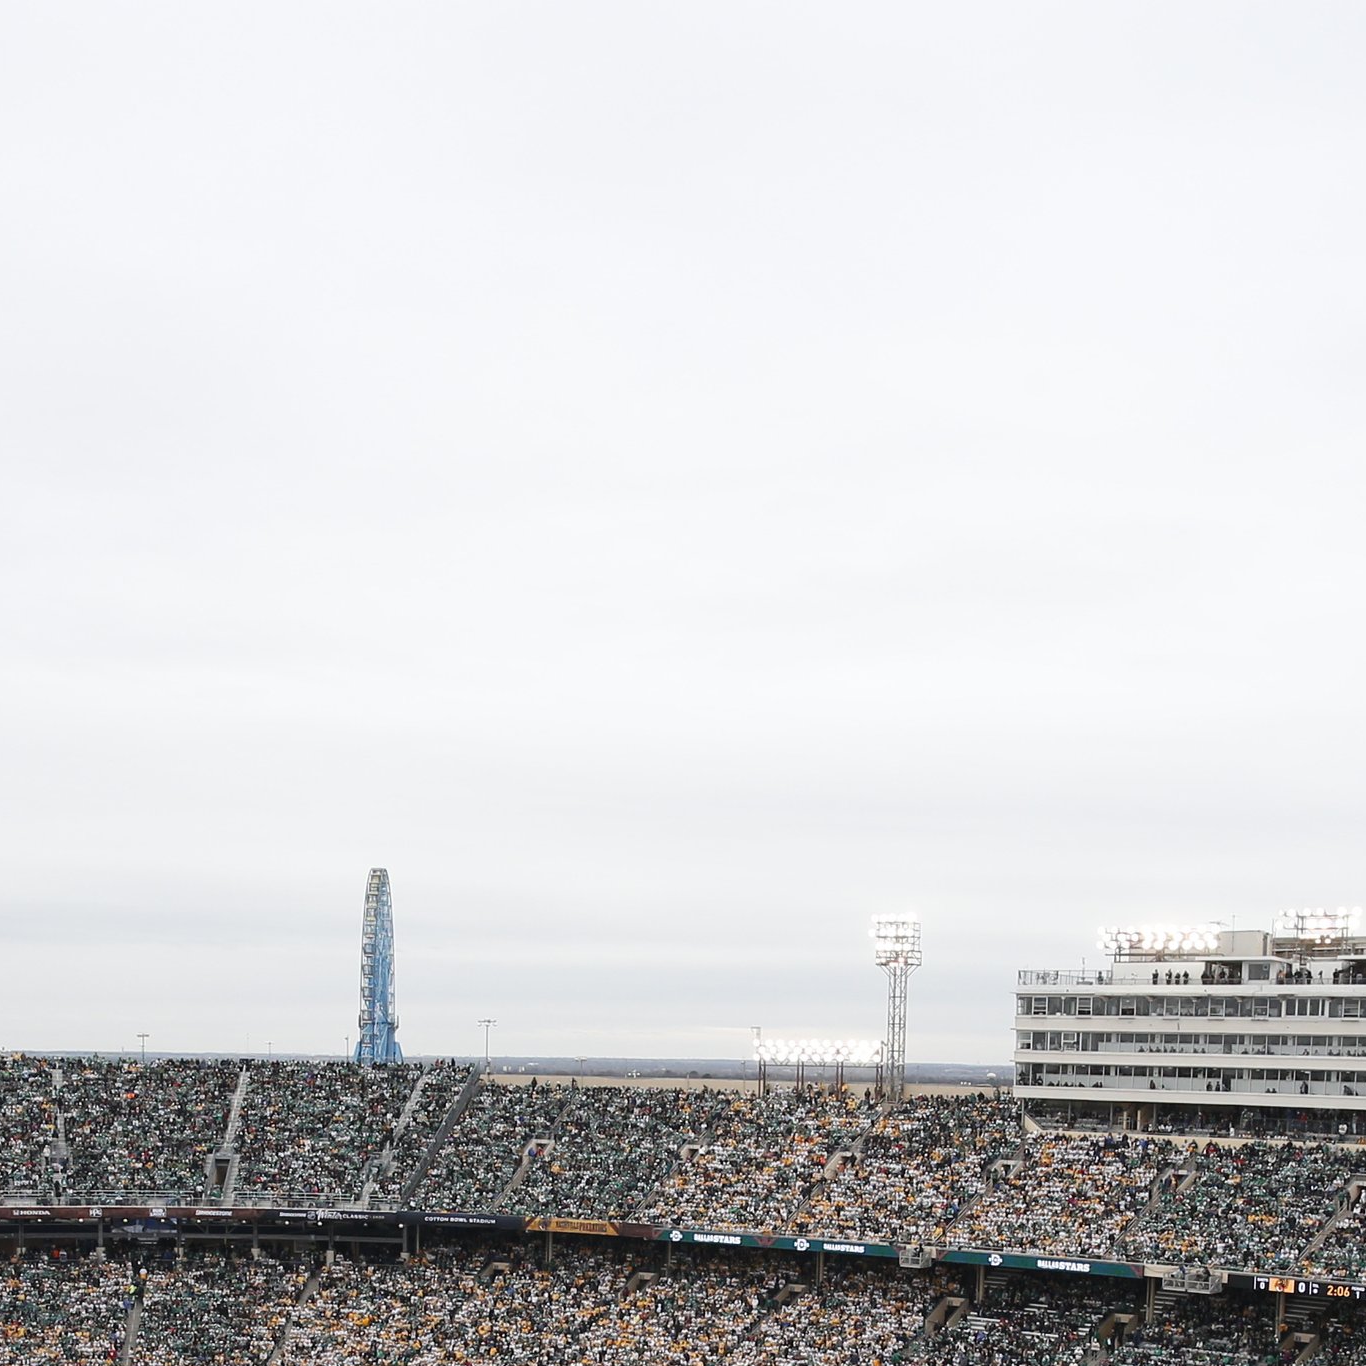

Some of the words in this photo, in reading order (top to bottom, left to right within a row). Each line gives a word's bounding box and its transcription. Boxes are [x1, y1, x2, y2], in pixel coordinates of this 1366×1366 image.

[195, 1209, 233, 1217] BRIDGESTONE
[693, 1233, 714, 1243] DALLAS
[713, 1234, 741, 1245] STARS
[823, 1242, 841, 1251] DALLAS
[839, 1244, 865, 1254] STARS
[1037, 1259, 1060, 1270] DALLAS
[1059, 1260, 1090, 1273] STARS
[1298, 1282, 1306, 1293] 0
[1326, 1285, 1351, 1298] 2:06
